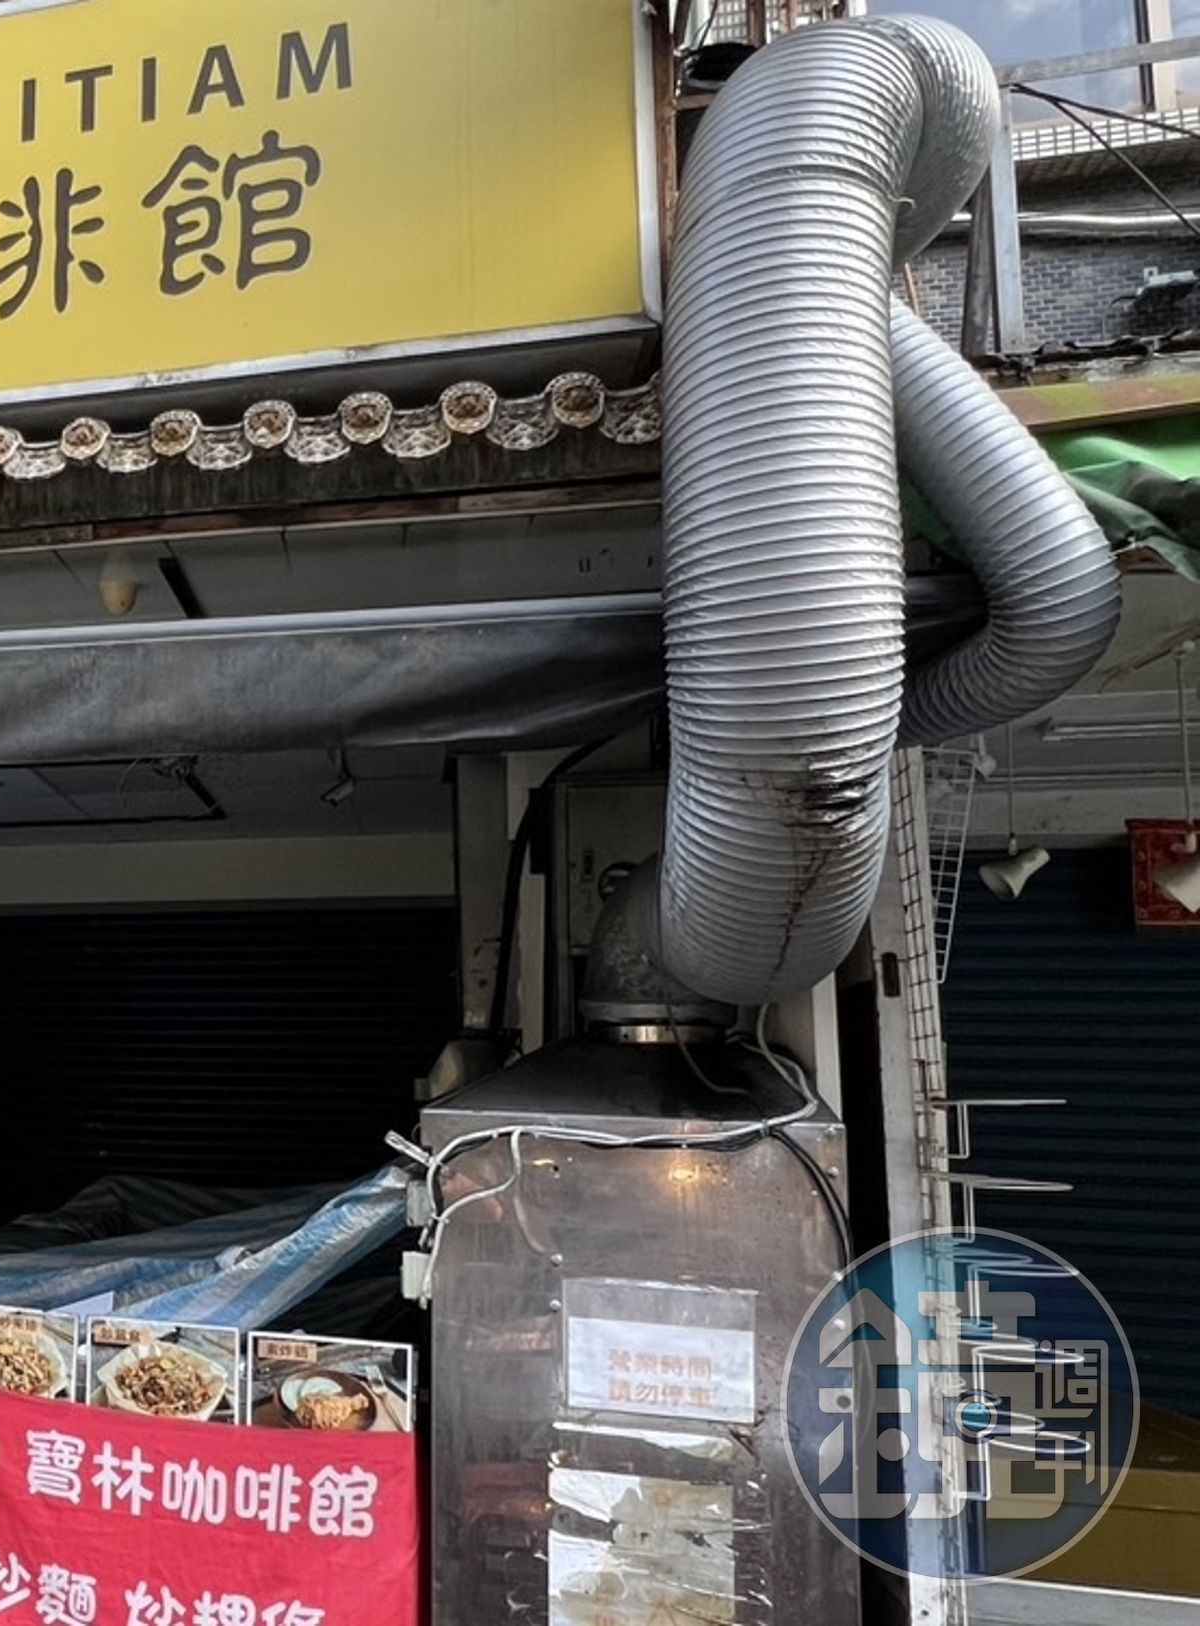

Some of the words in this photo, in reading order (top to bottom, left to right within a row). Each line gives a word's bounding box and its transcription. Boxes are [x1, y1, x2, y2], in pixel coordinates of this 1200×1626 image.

[25, 1429, 378, 1538] 寶林咖啡館
